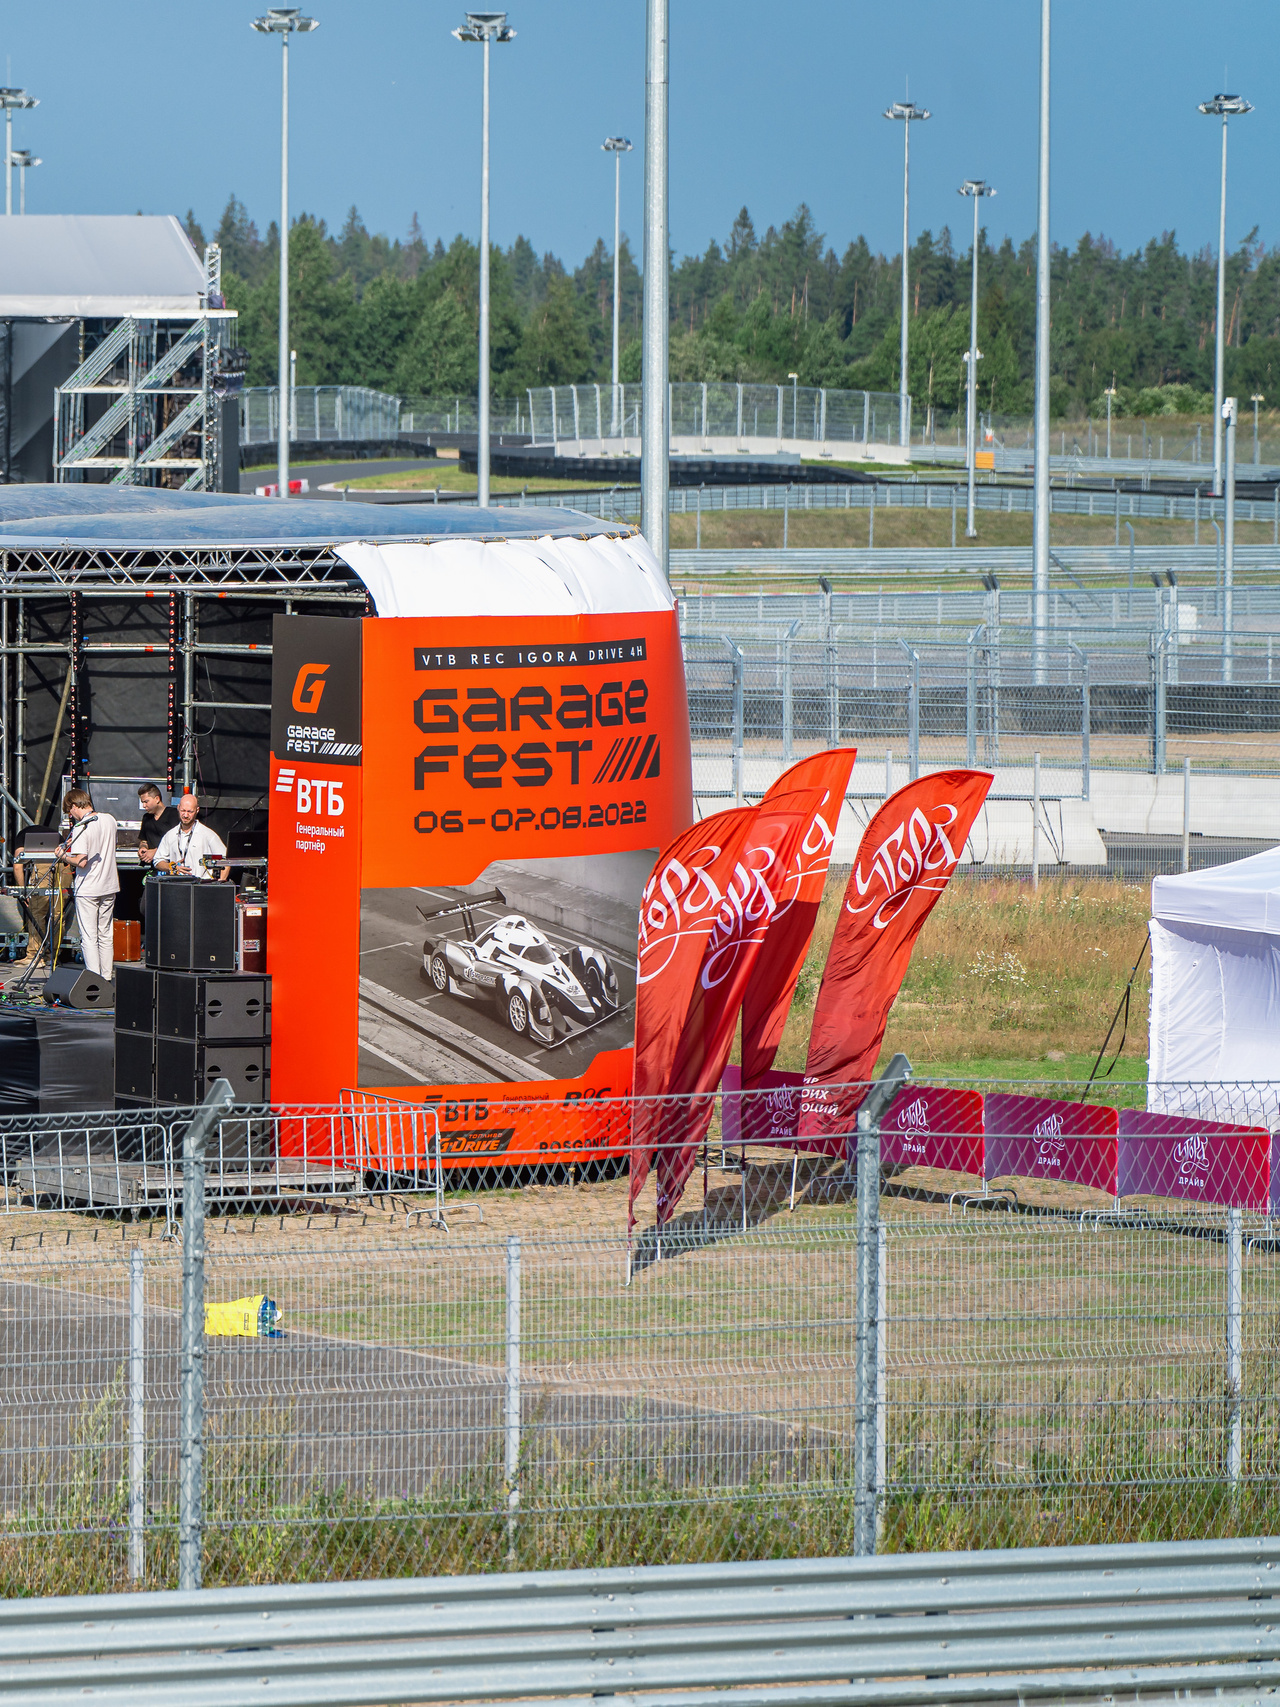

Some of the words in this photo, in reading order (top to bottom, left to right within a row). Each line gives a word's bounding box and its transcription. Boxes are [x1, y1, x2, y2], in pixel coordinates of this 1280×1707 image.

[422, 654, 457, 666] VTB
[470, 652, 505, 665] REC
[518, 650, 578, 664] IGORA
[588, 647, 623, 661] DRIVE
[630, 645, 643, 657] 4H
[296, 778, 345, 817] ВТБ
[295, 821, 345, 838] Генеральный
[295, 838, 326, 854] партнёр
[802, 1076, 820, 1085] ИР
[801, 1088, 830, 1100] ОИХ
[445, 1098, 489, 1122] ВТБ
[800, 1102, 839, 1116] ОЦИЙ
[902, 1143, 926, 1153] ДРАЙВ
[1037, 1156, 1061, 1166] ДРАЙВ
[1178, 1176, 1204, 1187] ДРАЙВ
